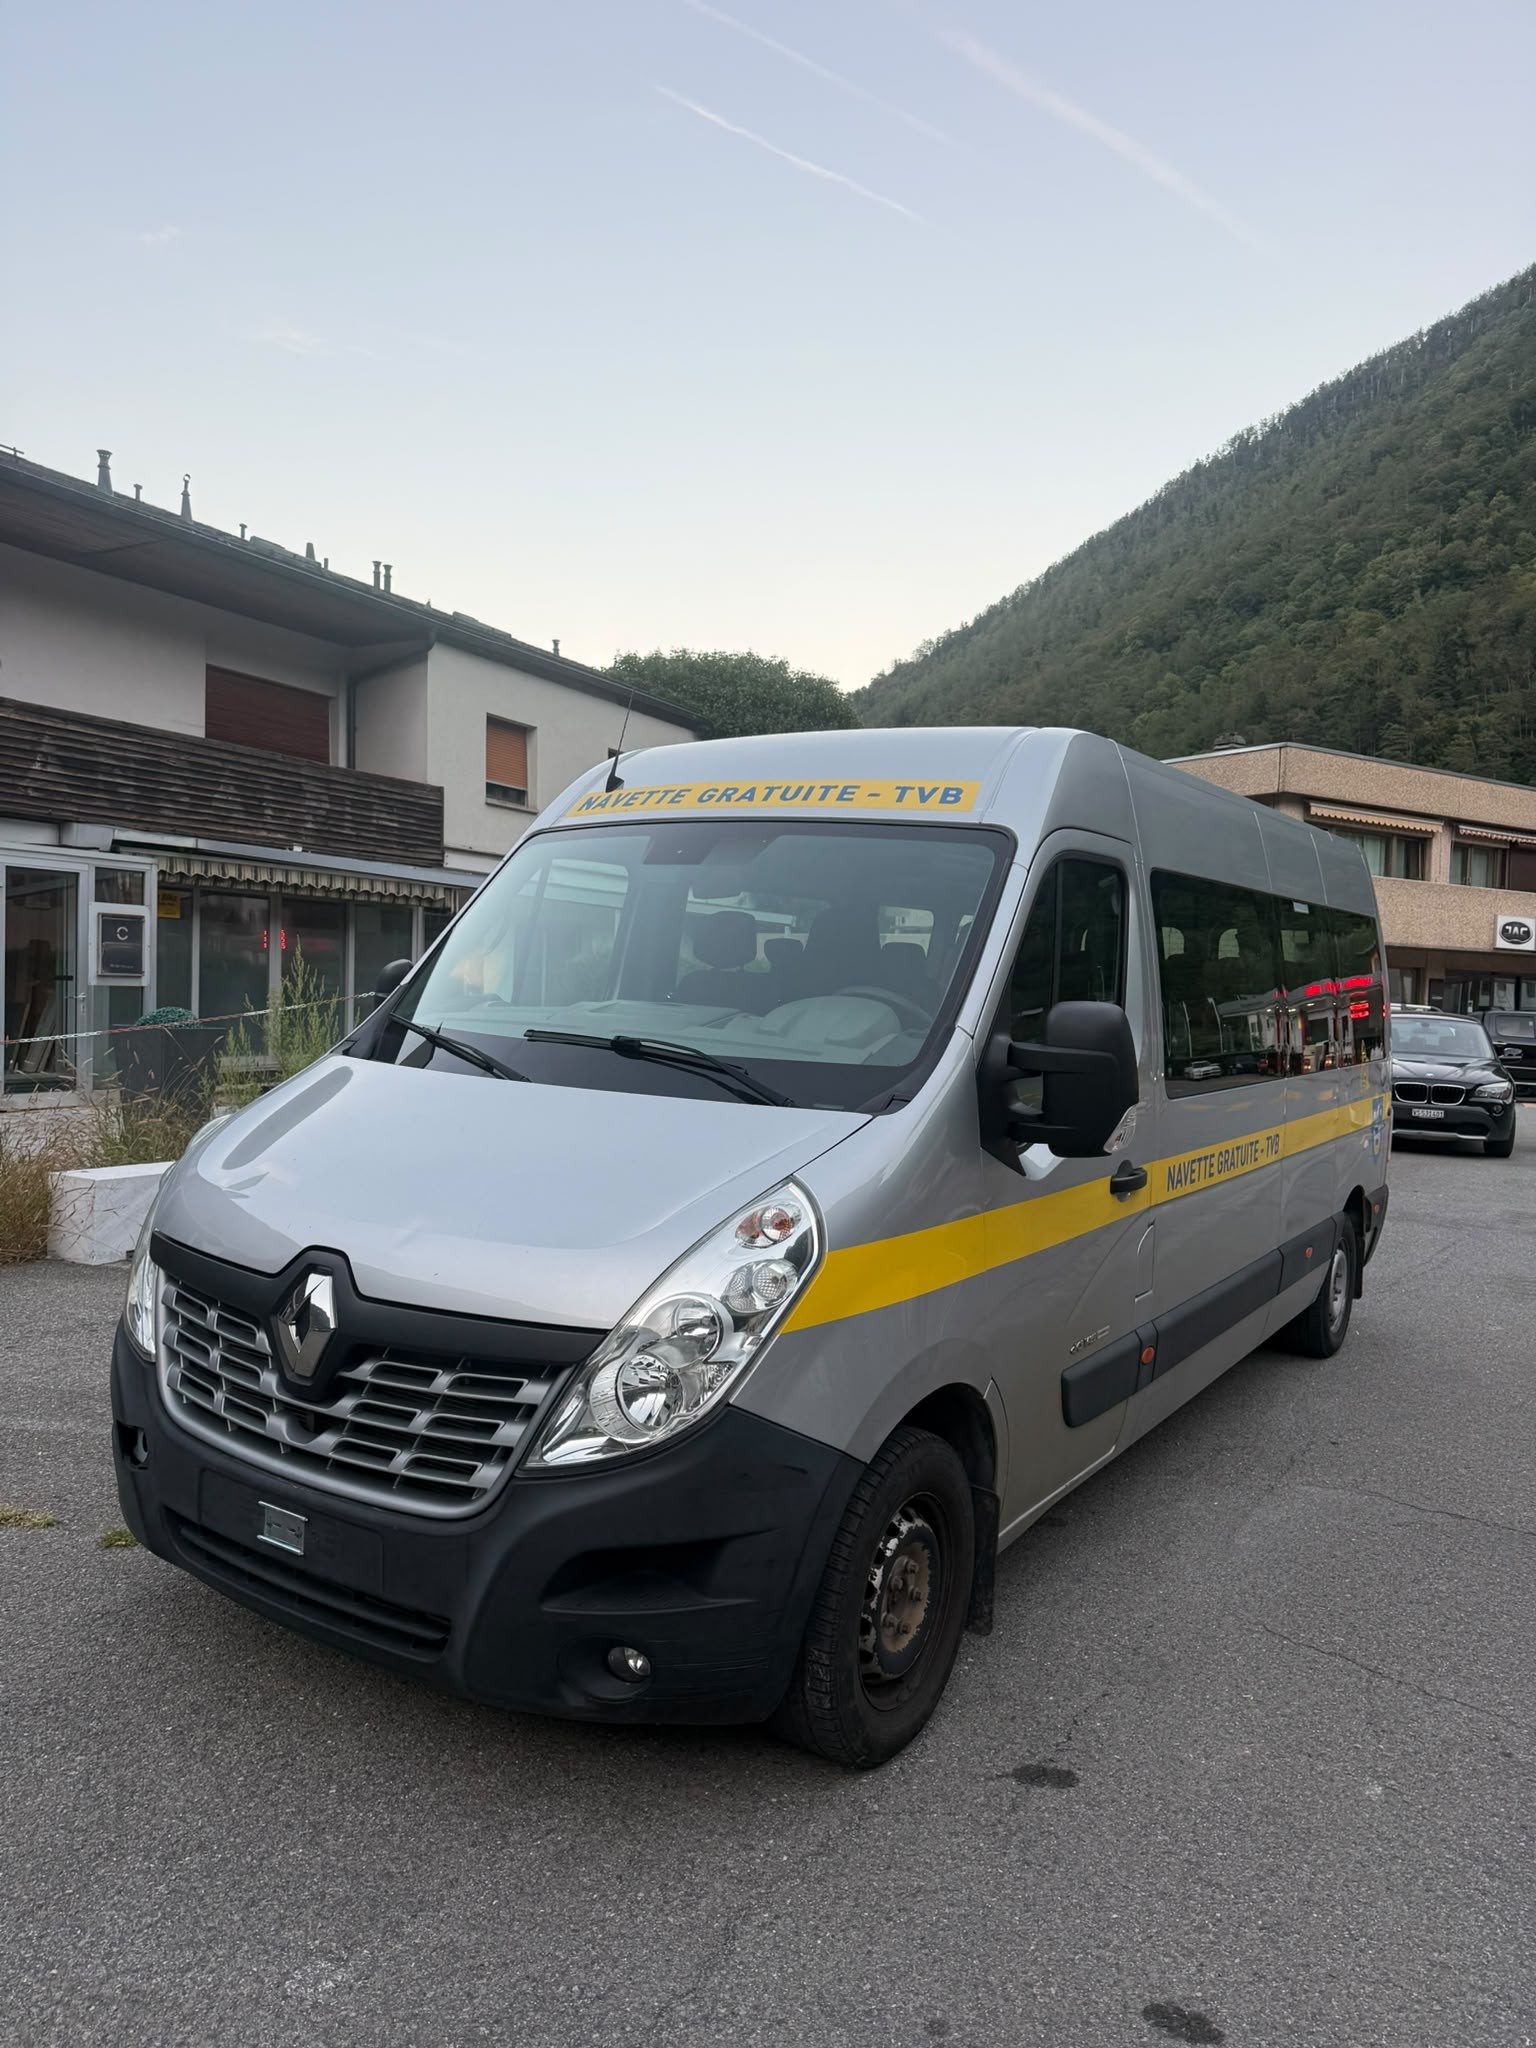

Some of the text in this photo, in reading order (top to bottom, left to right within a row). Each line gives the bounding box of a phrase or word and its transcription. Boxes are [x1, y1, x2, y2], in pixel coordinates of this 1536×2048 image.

[577, 788, 692, 812] NAVETTE
[697, 785, 861, 803] GRATUITE
[895, 786, 964, 805] TVB
[1167, 1153, 1215, 1192] NAVETTE
[1217, 1140, 1259, 1175] GRATUITE
[1266, 1134, 1280, 1157] TVB
